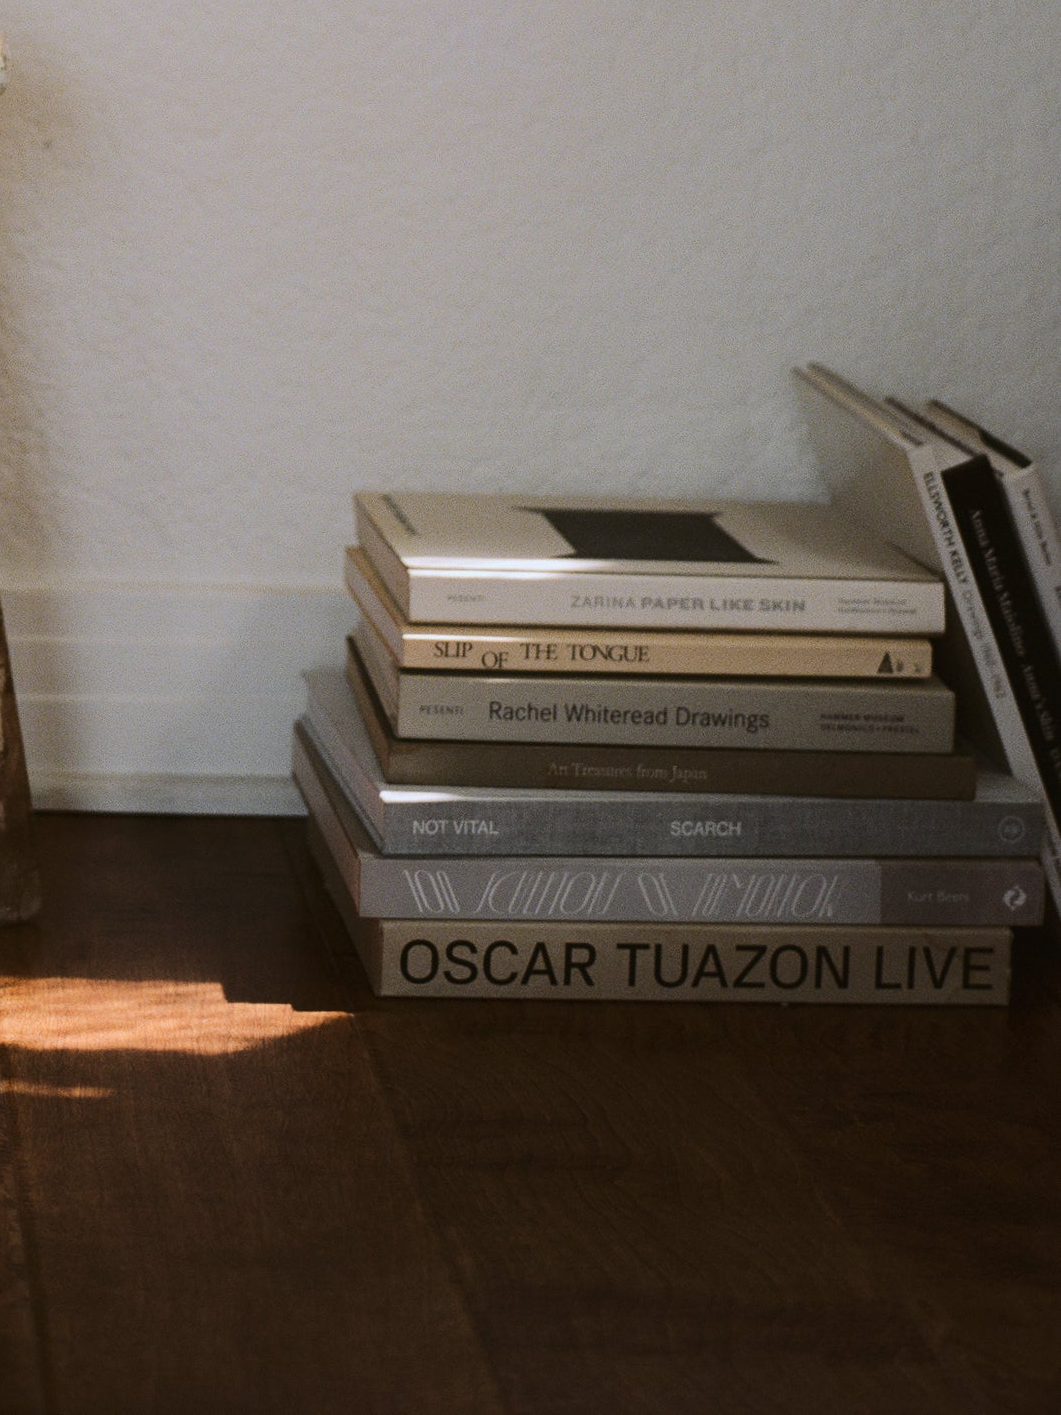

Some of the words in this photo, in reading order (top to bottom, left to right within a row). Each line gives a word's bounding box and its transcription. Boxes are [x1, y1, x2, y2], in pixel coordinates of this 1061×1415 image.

[922, 471, 956, 547] ELLSWORTH
[949, 548, 970, 584] KELLY
[970, 507, 989, 544] Anna
[983, 547, 1004, 589] Maria
[998, 591, 1027, 656] Maiolino
[570, 594, 636, 609] ZARINA
[641, 596, 704, 611] PAPER
[709, 599, 753, 612] LIKE
[758, 599, 806, 612] SKIN
[434, 641, 473, 659] SLIP
[481, 651, 509, 669] OF
[520, 643, 558, 661] THE
[566, 644, 650, 663] TONGUE
[489, 701, 558, 722] Rachel
[564, 703, 668, 726] Whiteread
[675, 706, 770, 732] Drawings
[571, 762, 633, 778] Treasures
[637, 763, 668, 778] from
[671, 763, 707, 783] Japan
[413, 820, 448, 835] NOT
[452, 820, 498, 834] VITAL
[670, 821, 742, 836] SCARCH
[400, 939, 597, 987] OSCAR
[617, 943, 851, 989] TUAZON
[874, 946, 995, 991] LIVE
